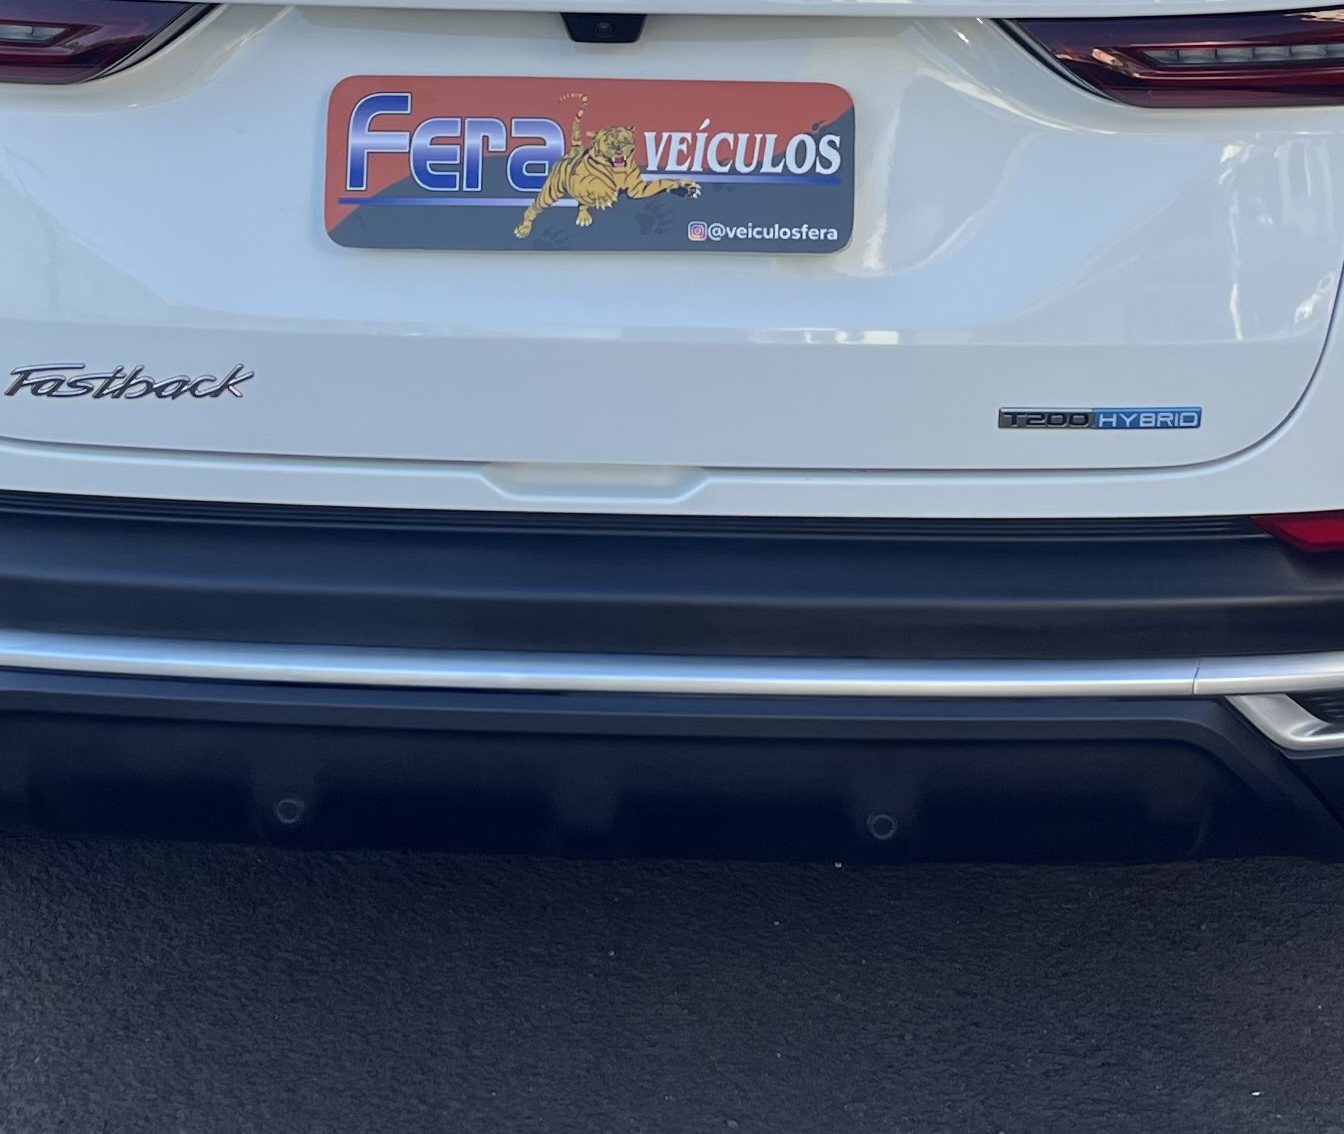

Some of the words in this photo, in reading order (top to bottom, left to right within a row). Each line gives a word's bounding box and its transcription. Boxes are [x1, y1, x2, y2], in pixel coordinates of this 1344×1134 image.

[345, 92, 566, 192] Fera
[643, 118, 842, 176] VEÍCULOS
[707, 222, 839, 242] @veiculosfera
[4, 363, 255, 399] Fastback
[1002, 411, 1090, 428] T200
[1098, 411, 1199, 427] HYBRID
